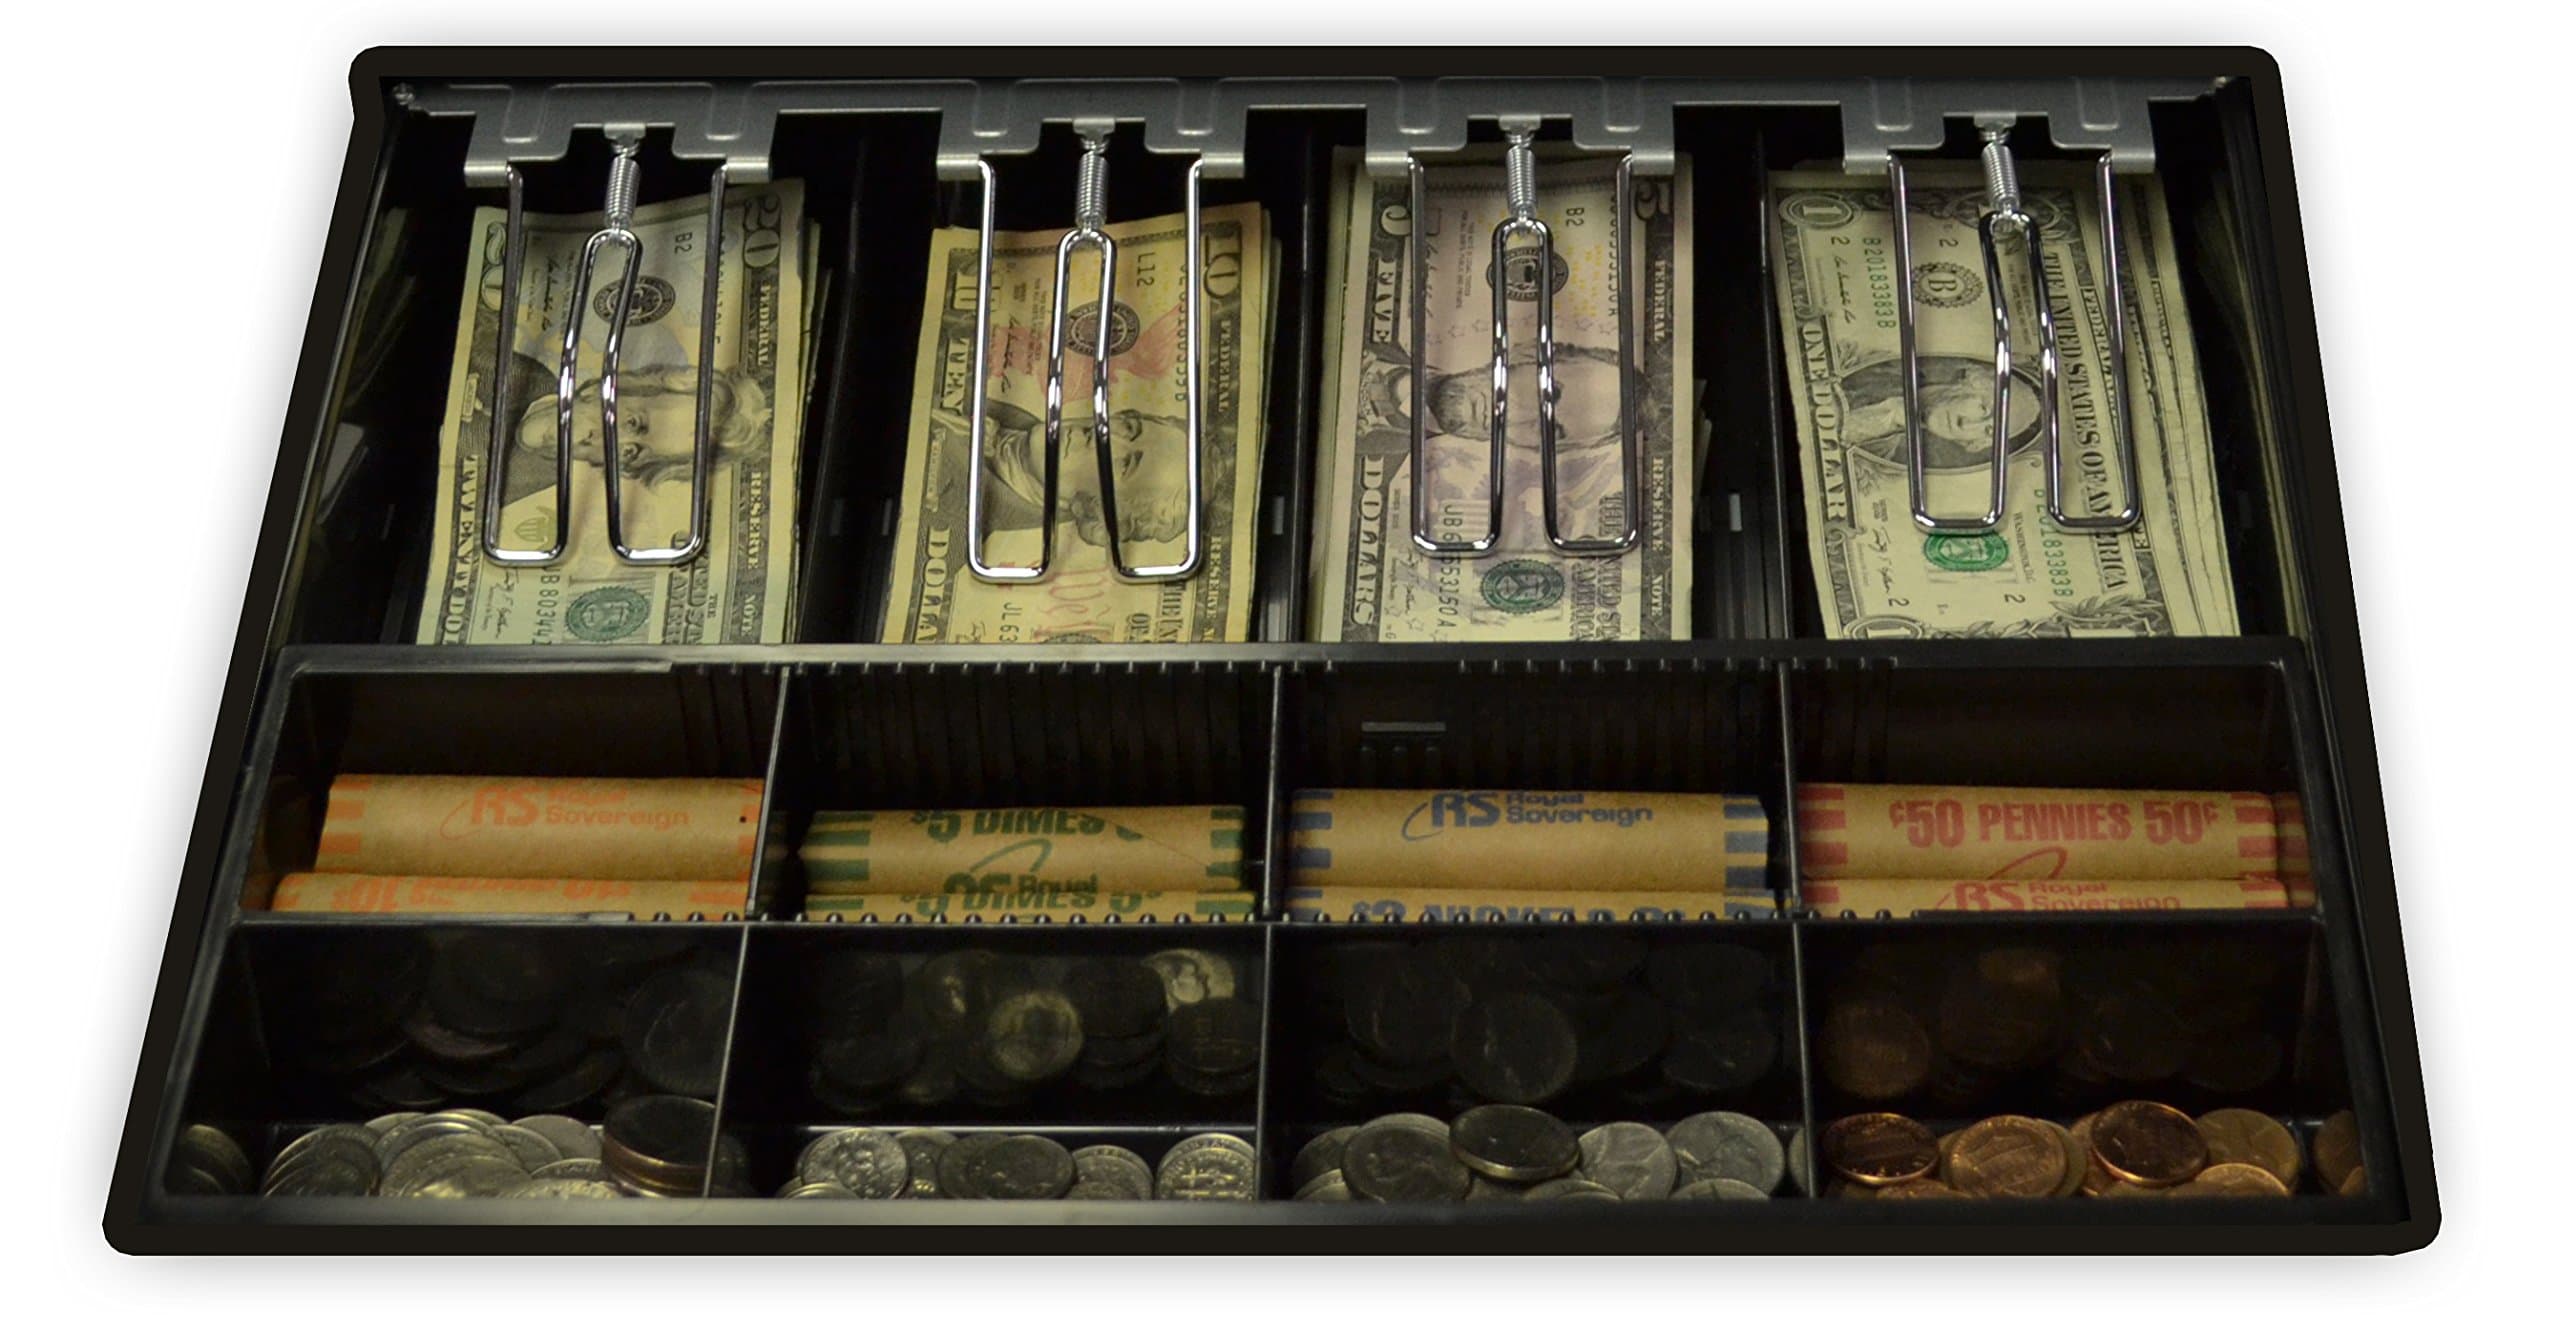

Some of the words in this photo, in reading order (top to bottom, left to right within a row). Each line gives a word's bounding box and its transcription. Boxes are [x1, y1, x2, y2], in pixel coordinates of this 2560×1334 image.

[1565, 206, 1586, 228] B2
[674, 231, 694, 255] B2
[1203, 228, 1243, 299] 10
[1830, 235, 1851, 247] 2
[1938, 238, 1960, 249] 2
[1136, 251, 1157, 287] L12
[1927, 277, 1958, 293] B
[2043, 252, 2068, 290] THE
[1371, 256, 1397, 344] FIVE
[1653, 259, 1668, 343] FEDERAL
[757, 280, 773, 366] FEDERAL
[2048, 292, 2083, 360] UNITED
[1216, 318, 1232, 413] FEDERAL
[1802, 322, 1831, 382] ONE
[941, 336, 970, 415] TEN
[2065, 361, 2101, 446] STATES
[1811, 383, 1847, 521] DOLLAR
[2081, 450, 2108, 484] OF
[454, 454, 479, 598] TWENTY
[748, 471, 763, 570] RESERVE
[1651, 456, 1666, 552] RESERVE
[1350, 455, 1385, 626] DOLLARS
[1204, 535, 1222, 619] RESERVE
[1599, 544, 1623, 608] NITED
[1650, 574, 1664, 618] NOTE
[2004, 593, 2026, 604] 2
[741, 593, 758, 638] NOTE
[1888, 597, 1910, 607] 2
[546, 804, 690, 831] Sovereign
[1431, 792, 1501, 828] RS
[1505, 790, 1585, 806] Royal
[1506, 805, 1654, 827] Sovereign
[1977, 802, 2134, 842] PENNIES
[2028, 882, 2108, 896] Royal
